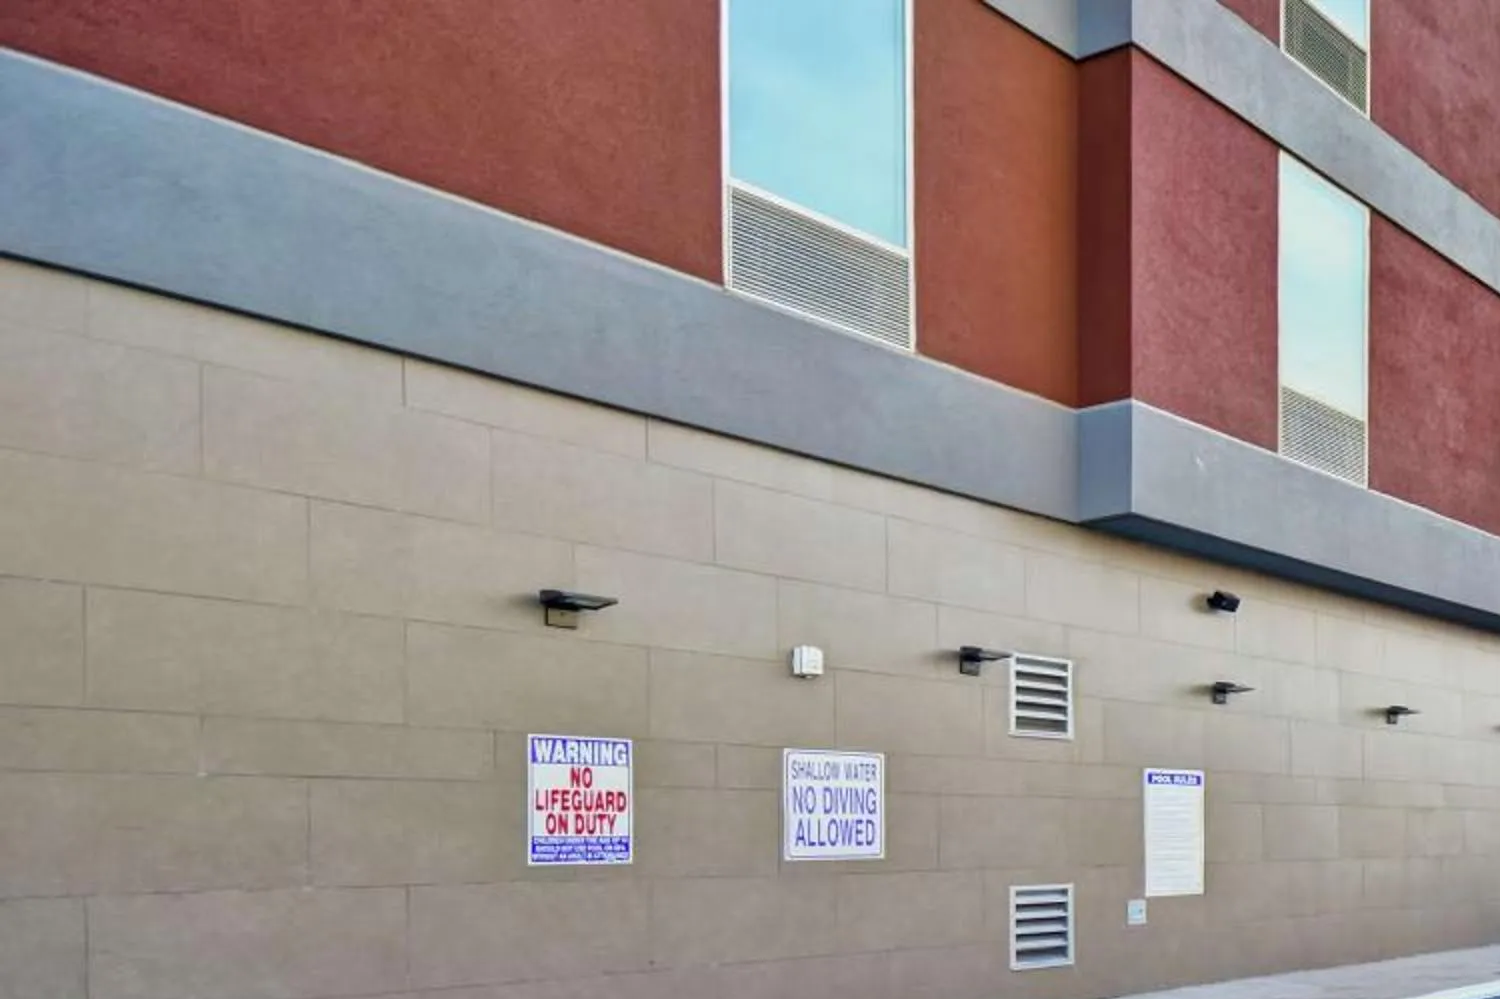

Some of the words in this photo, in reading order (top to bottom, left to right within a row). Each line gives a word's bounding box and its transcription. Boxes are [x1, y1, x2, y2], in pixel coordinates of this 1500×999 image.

[533, 739, 627, 765] WARNING
[570, 767, 593, 789] NO
[791, 760, 841, 781] SHALLOW
[845, 763, 877, 782] WATER
[1151, 774, 1172, 784] POOL
[535, 789, 627, 813] LIFEGUARD
[793, 786, 816, 814] NO
[823, 787, 877, 815] DIVING
[546, 813, 568, 835] ON
[575, 814, 617, 835] DUTY
[795, 818, 876, 847] ALLOWED
